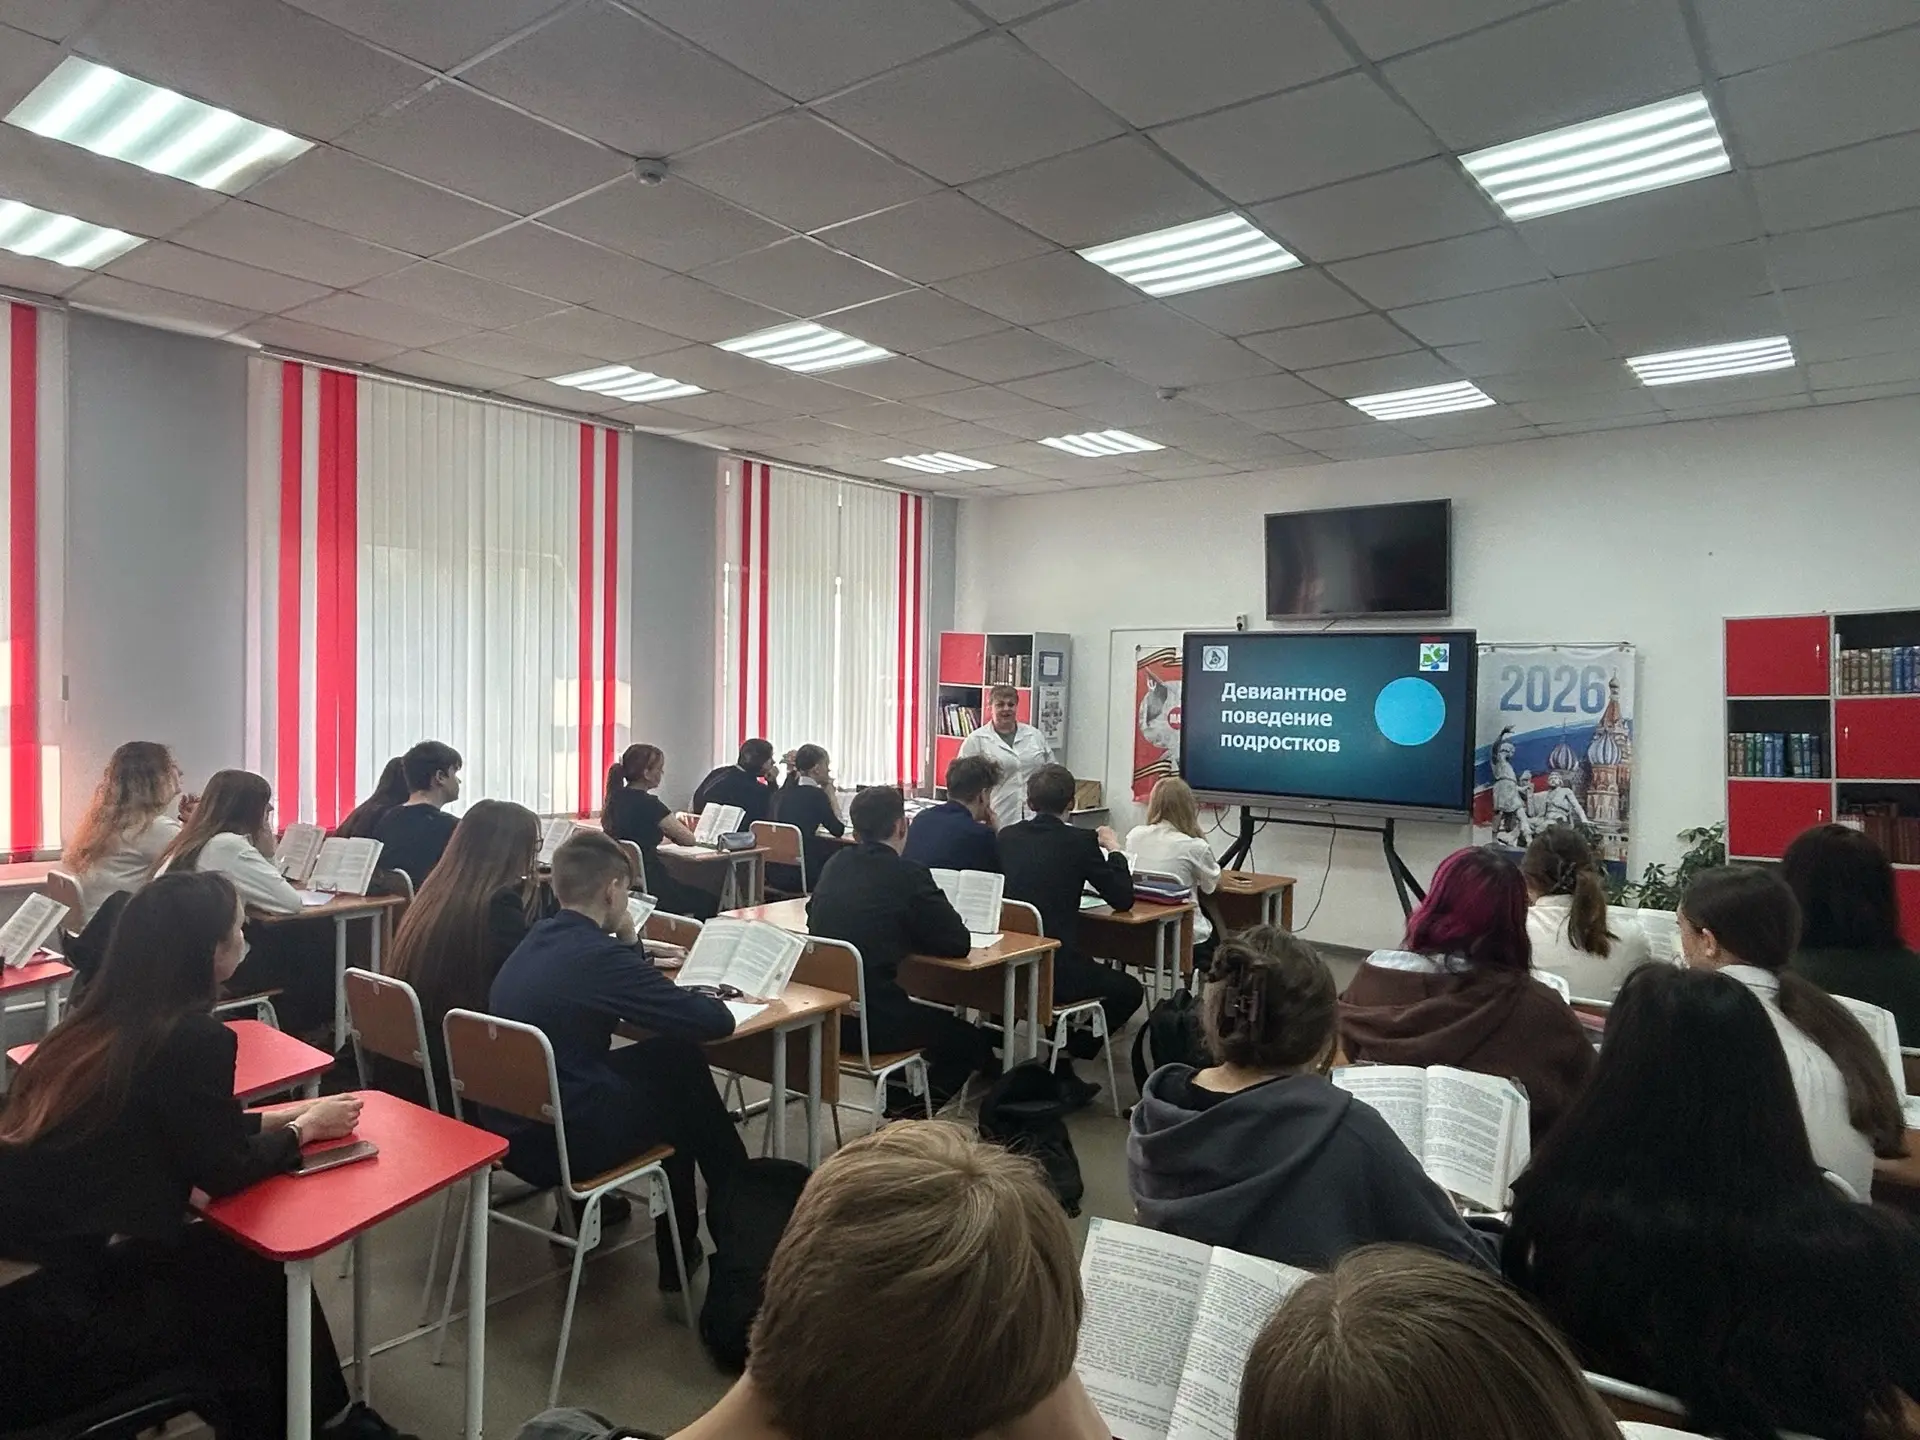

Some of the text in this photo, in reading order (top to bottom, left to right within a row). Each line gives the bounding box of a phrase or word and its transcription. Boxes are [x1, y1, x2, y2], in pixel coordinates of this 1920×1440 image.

[1221, 682, 1347, 702] Девиантное
[1500, 664, 1606, 714] 2026
[1221, 710, 1333, 728] поведение
[1220, 733, 1341, 753] подростков
